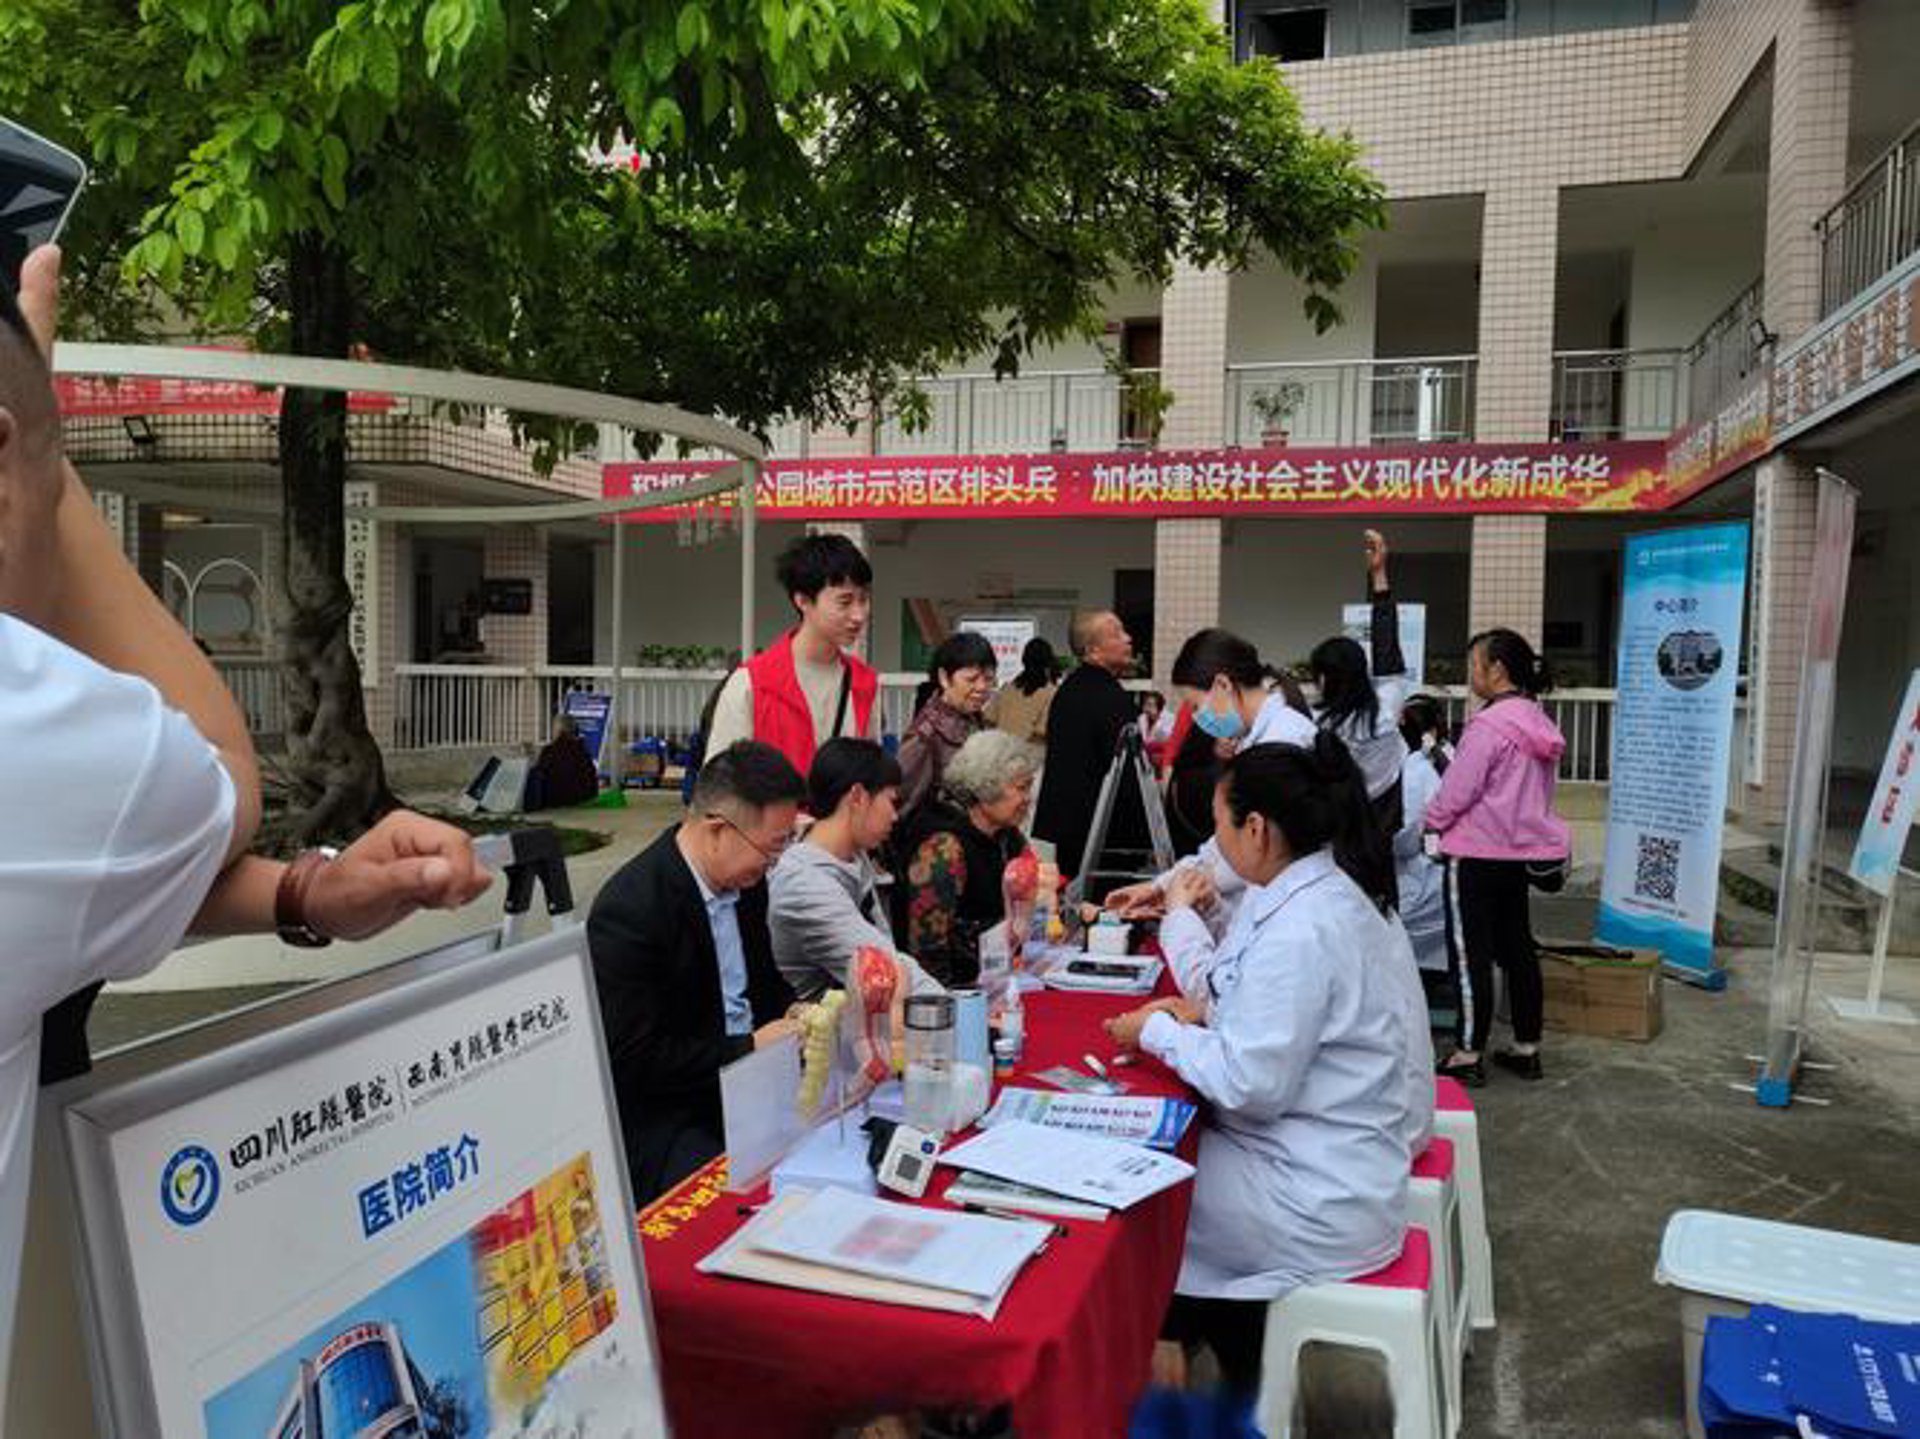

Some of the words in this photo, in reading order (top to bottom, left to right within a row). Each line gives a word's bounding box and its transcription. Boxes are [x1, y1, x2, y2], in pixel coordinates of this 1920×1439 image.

[1092, 454, 1610, 503] 加快建设社会主义现代化新成华
[358, 1132, 480, 1240] 医院简介
